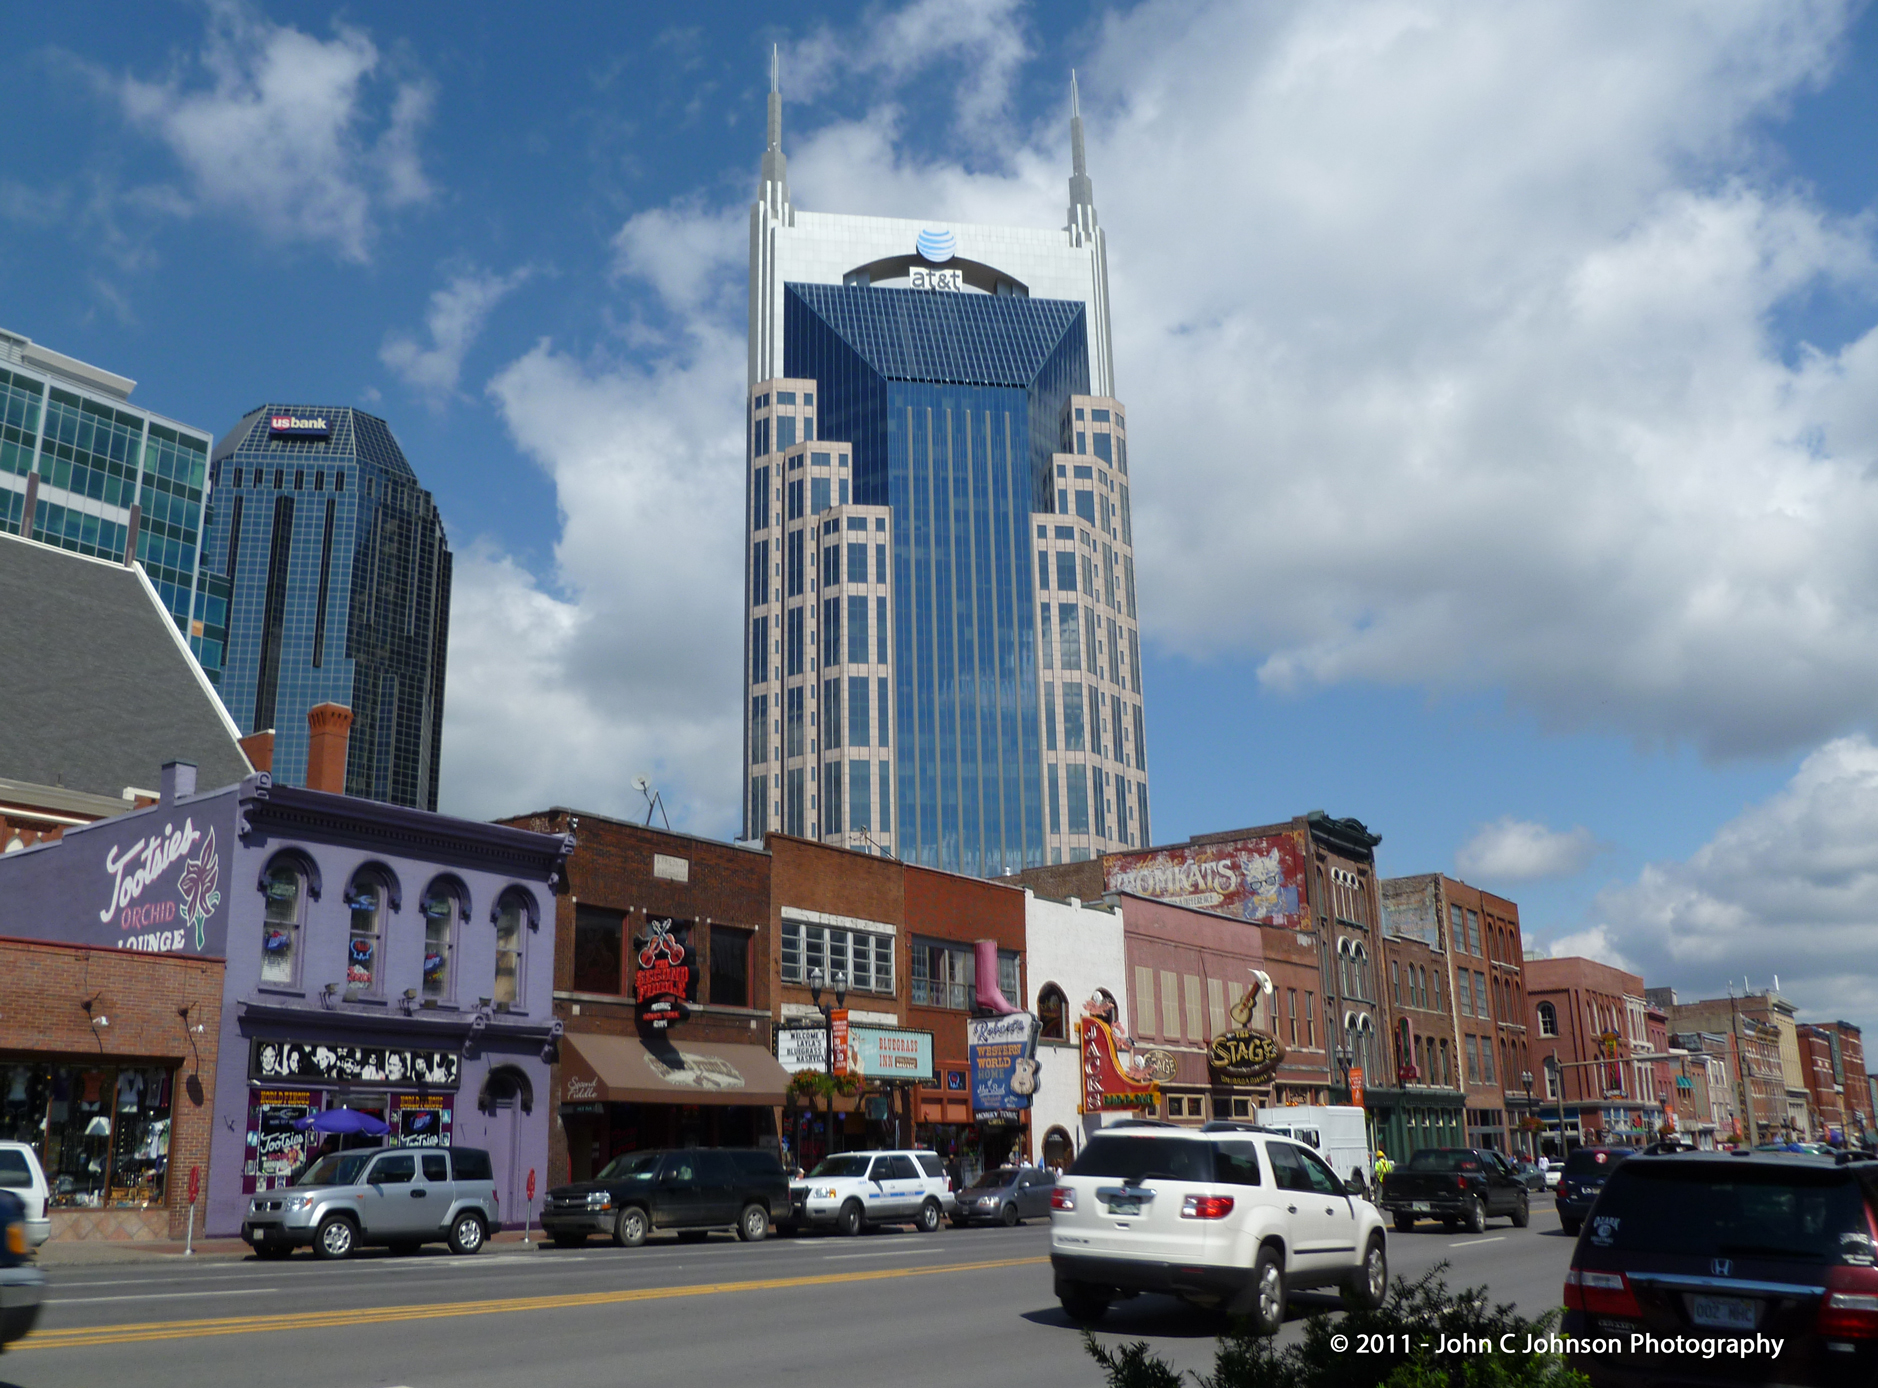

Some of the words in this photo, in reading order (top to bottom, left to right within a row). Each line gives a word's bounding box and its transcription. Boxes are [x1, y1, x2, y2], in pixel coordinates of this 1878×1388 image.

[911, 269, 961, 292] at&t
[100, 817, 201, 923] Tootsies
[1115, 859, 1237, 896] TOMKATS
[121, 901, 176, 930] ORCHID
[636, 966, 689, 985] SECOND
[637, 981, 687, 1004] FIDDLE
[790, 1032, 819, 1040] WELCOME
[797, 1040, 821, 1048] LAYLA'S
[879, 1037, 918, 1053] BLUEGRASS
[976, 1045, 1022, 1056] WESTERN
[1211, 1037, 1277, 1068] STAGE
[879, 1054, 893, 1068] INN
[976, 1057, 1011, 1068] WORLD
[978, 1070, 1004, 1079] HOME
[568, 1075, 598, 1093] Second
[260, 1091, 283, 1104] WORLD
[284, 1092, 310, 1105] FAMOUS
[568, 1087, 598, 1100] Fiddle
[260, 1131, 304, 1153] Tootsies
[1696, 1303, 1720, 1319] 002
